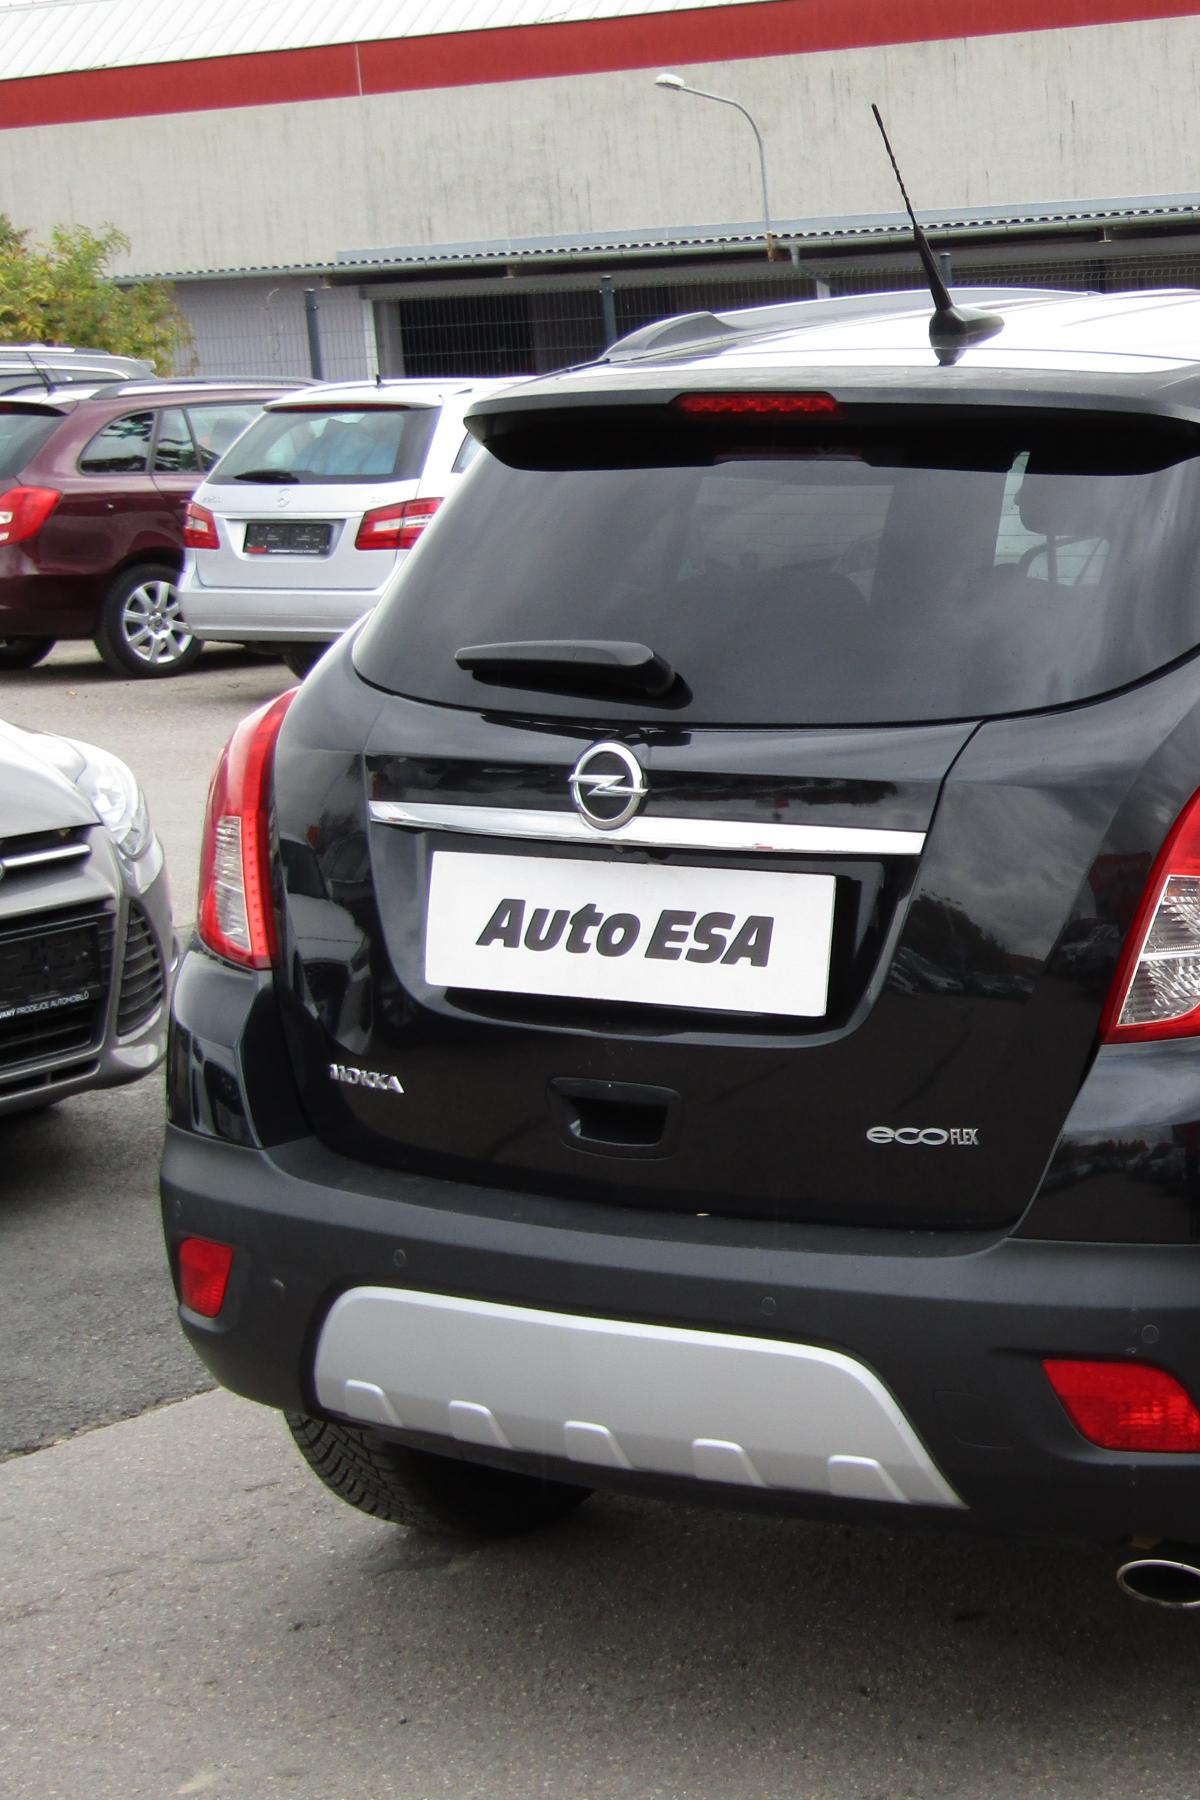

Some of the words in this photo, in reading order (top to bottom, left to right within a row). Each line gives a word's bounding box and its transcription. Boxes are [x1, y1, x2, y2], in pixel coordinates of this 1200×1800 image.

[475, 898, 642, 958] Auto
[644, 909, 775, 968] ESA
[16, 1001, 50, 1015] PRODEJCE
[329, 1063, 405, 1094] MOKKA
